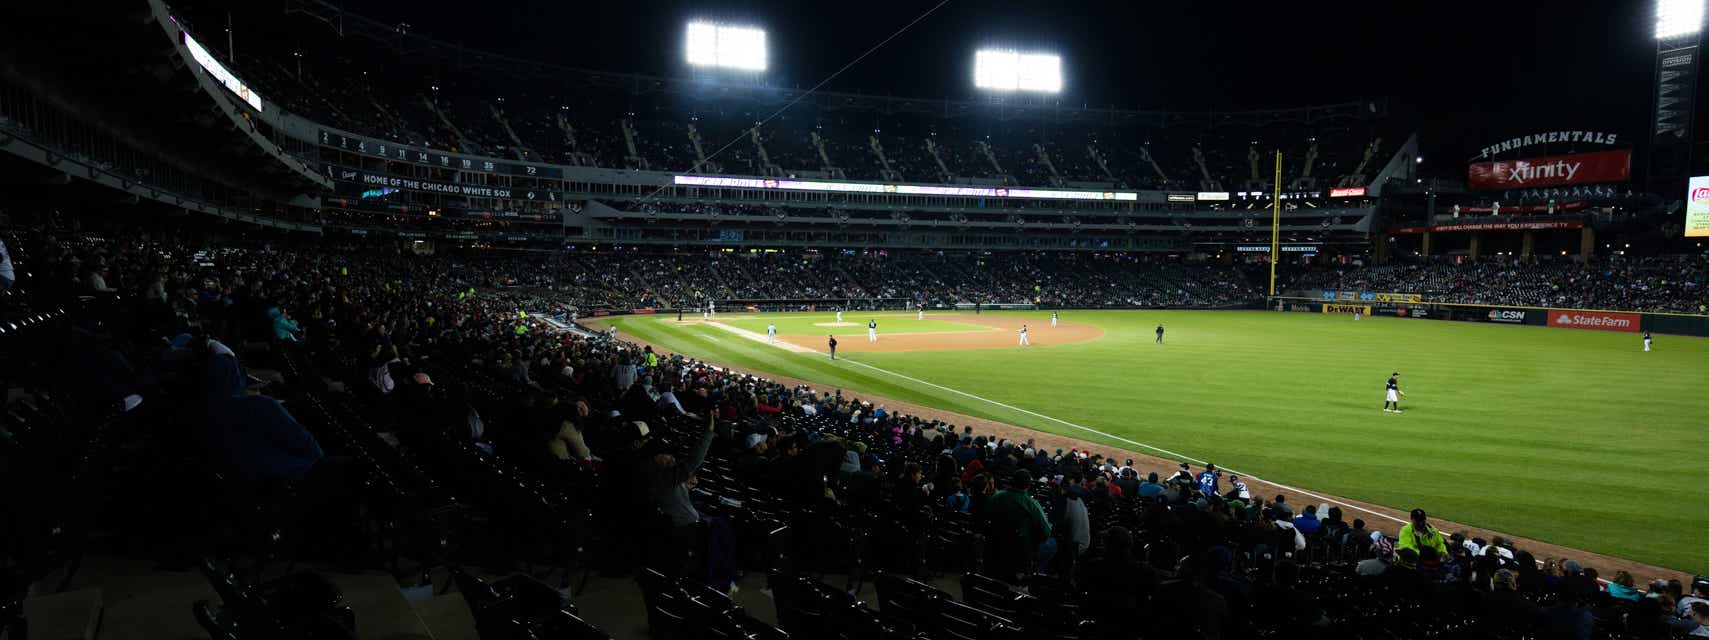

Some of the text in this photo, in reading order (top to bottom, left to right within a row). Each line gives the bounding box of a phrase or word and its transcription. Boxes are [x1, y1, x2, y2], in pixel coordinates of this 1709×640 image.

[1481, 131, 1616, 158] FUNDAMENTALS
[1508, 159, 1581, 183] xfinity
[364, 175, 389, 185] HOME
[390, 178, 400, 186] OF
[403, 180, 419, 188] THE
[422, 182, 460, 193] CHICAGO
[463, 186, 492, 196] WHITE
[494, 189, 511, 197] SOX
[1502, 310, 1525, 320] CSN
[1201, 476, 1214, 487] 43
